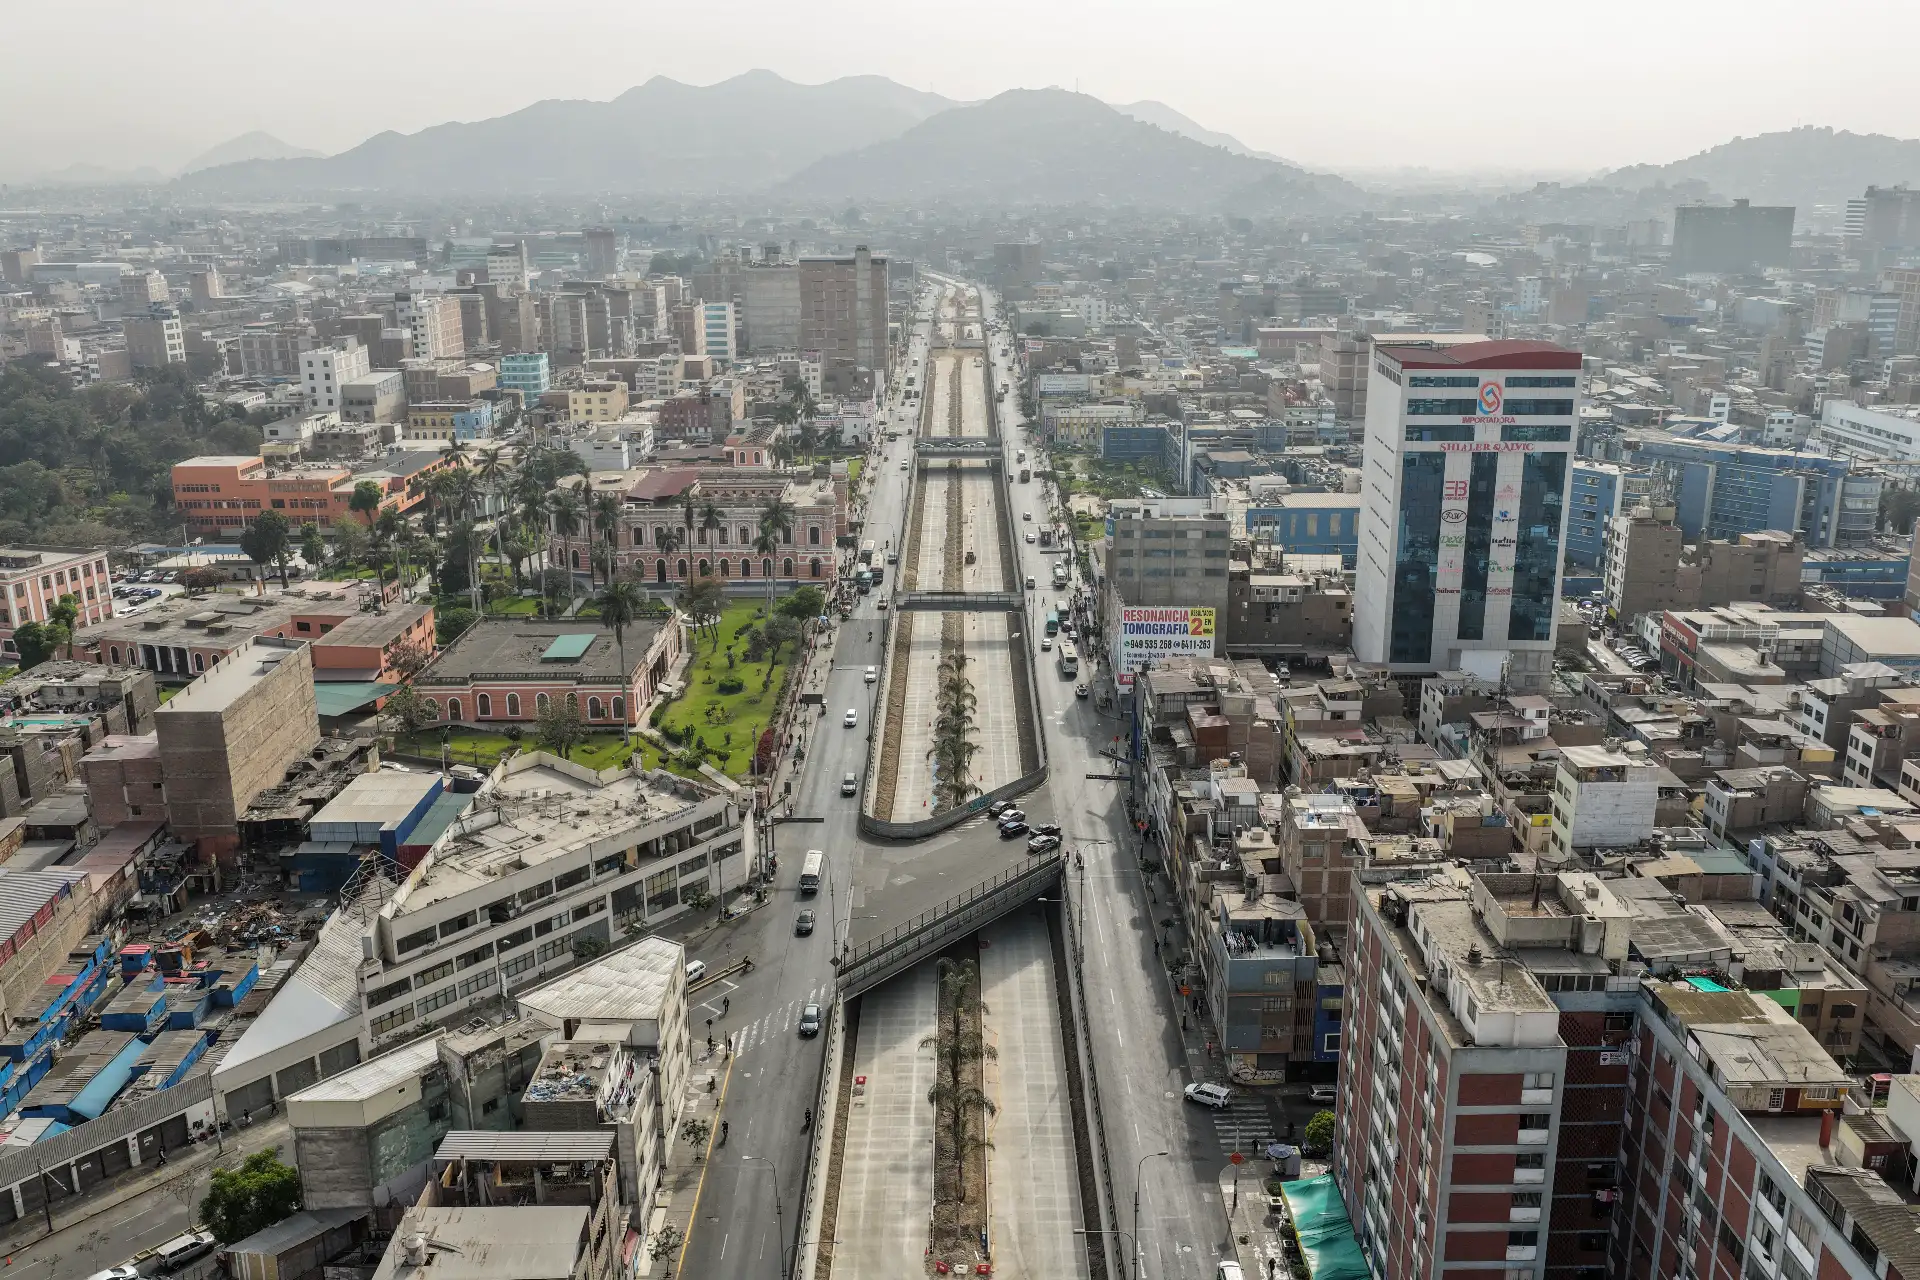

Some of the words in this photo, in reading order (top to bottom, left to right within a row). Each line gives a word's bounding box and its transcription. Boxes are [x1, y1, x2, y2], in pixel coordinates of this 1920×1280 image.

[1124, 610, 1189, 622] RESONANCIA
[1123, 623, 1189, 635] TOMOGRAFIA
[1191, 617, 1202, 635] 2
[1205, 618, 1212, 626] EN
[1130, 640, 1143, 649] 949
[1145, 640, 1157, 649] 535
[1160, 640, 1172, 649] 268
